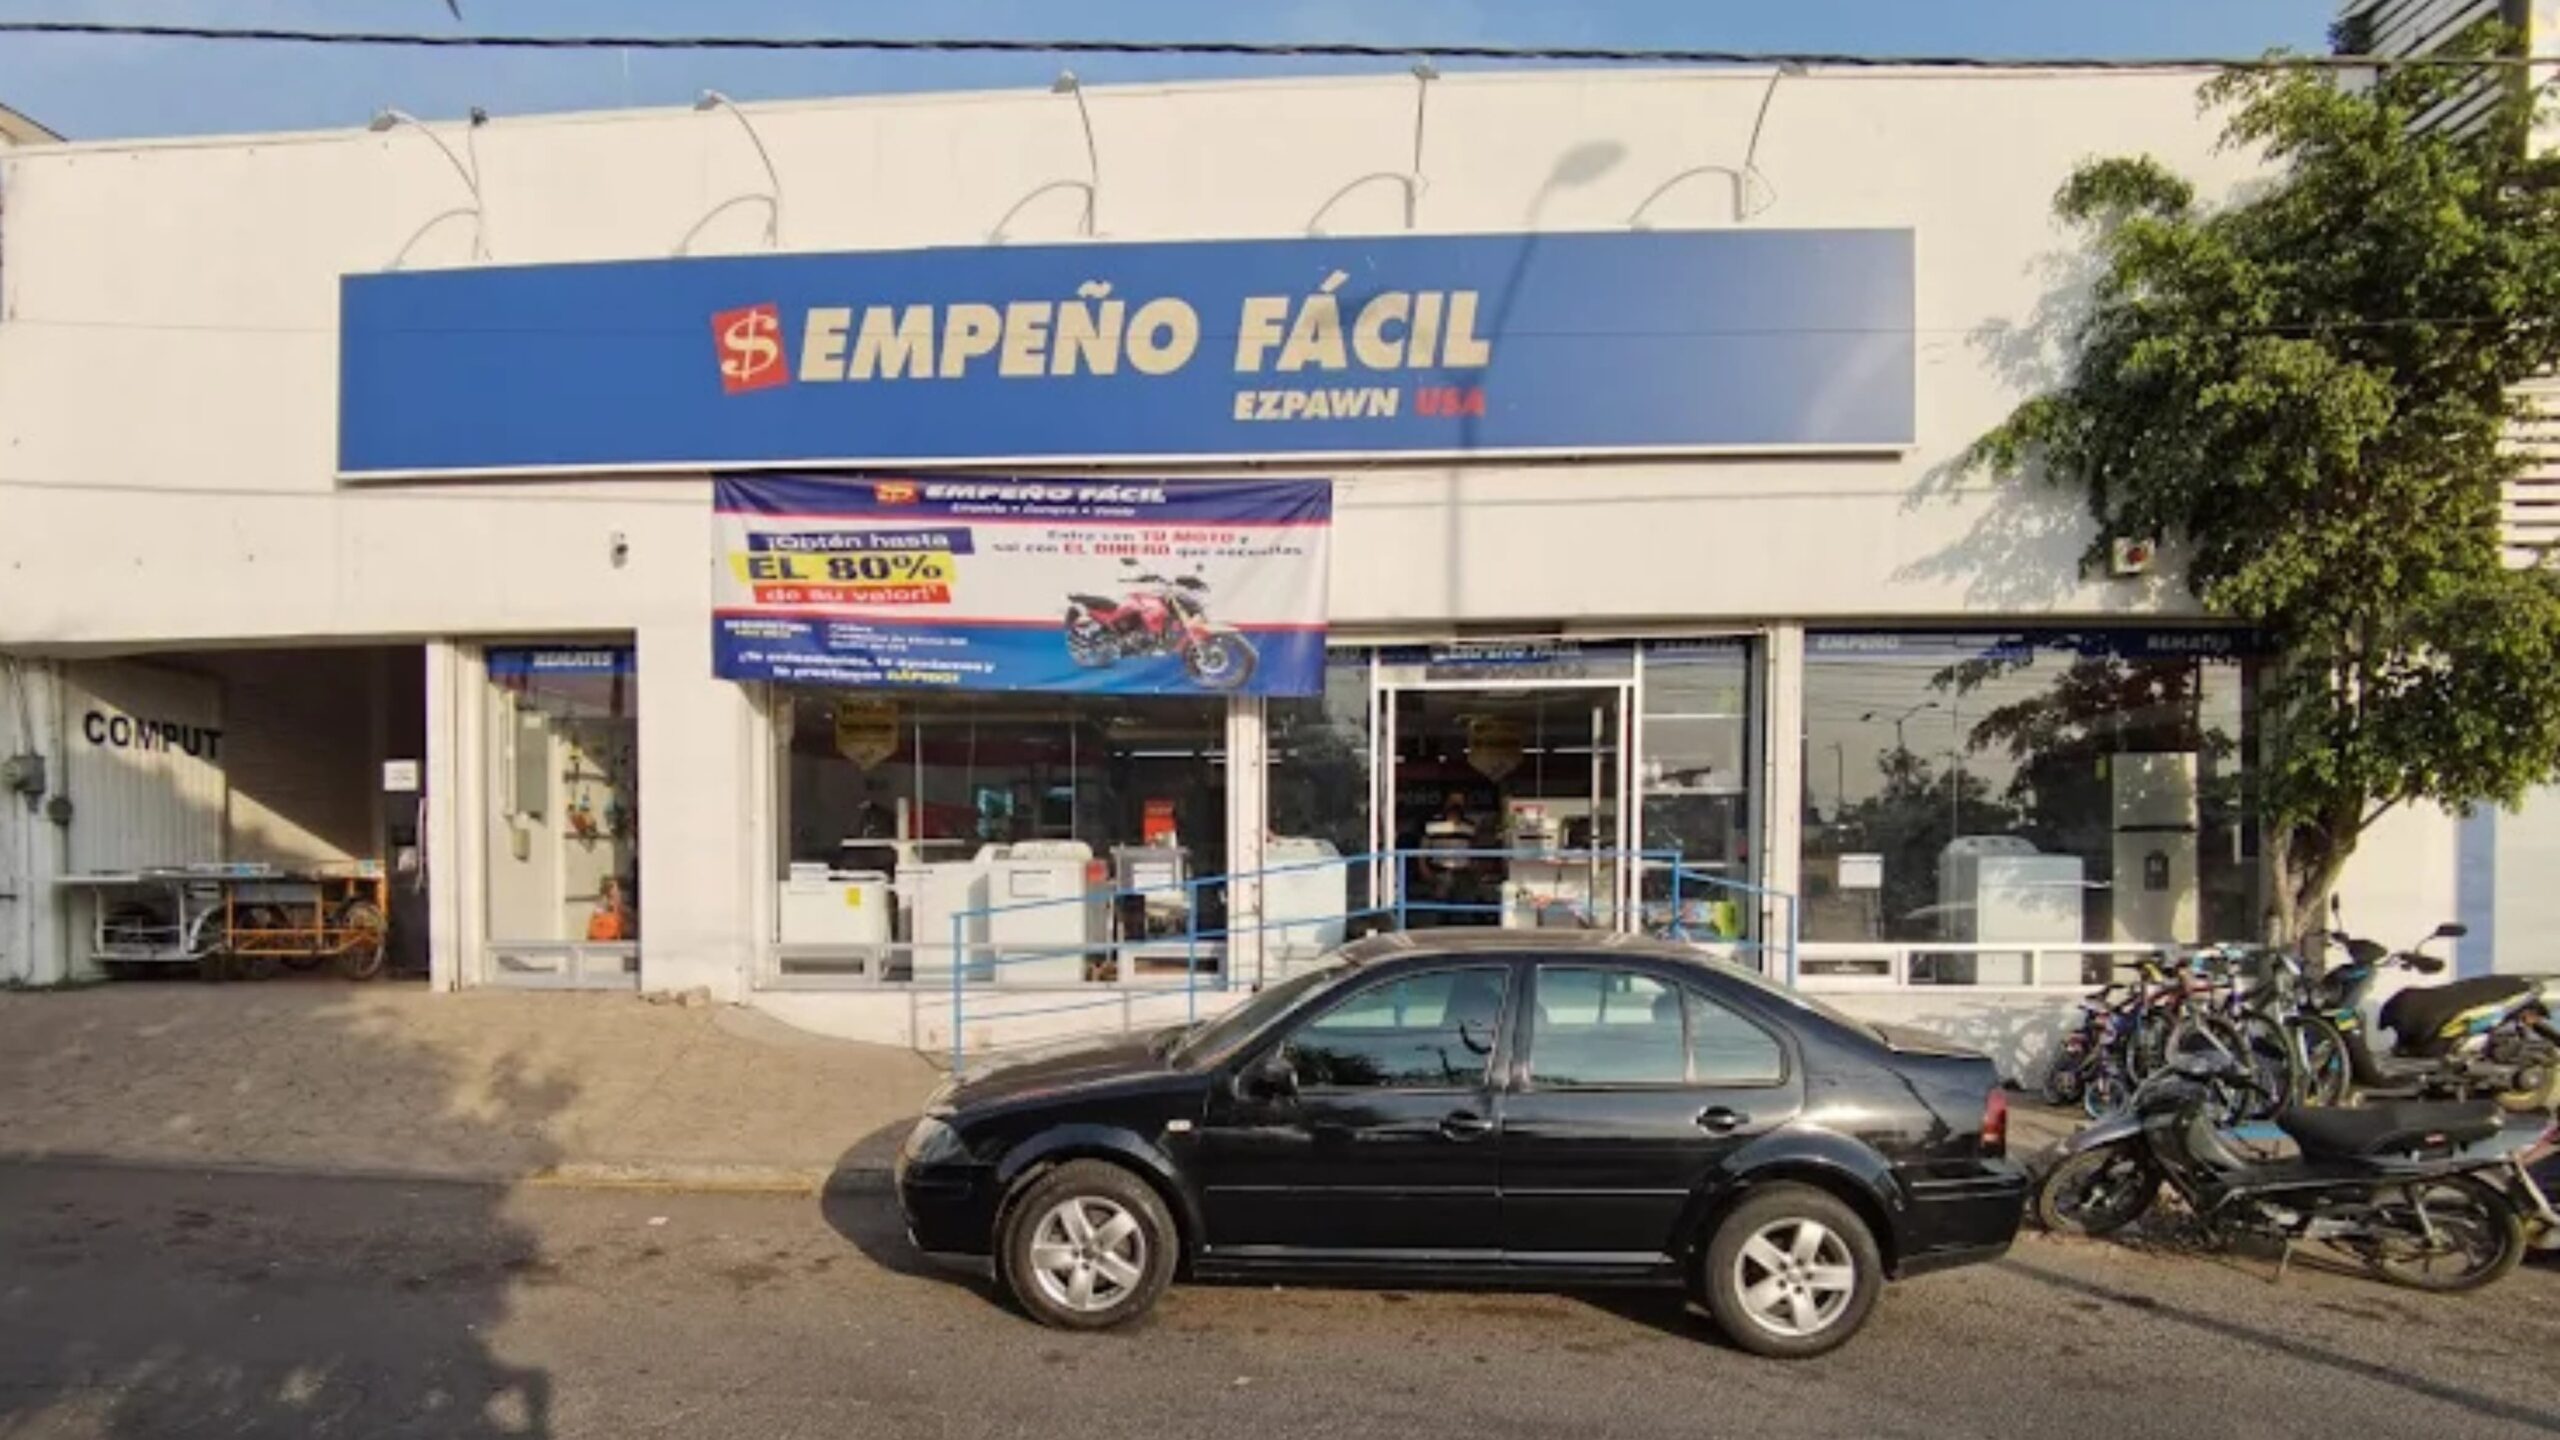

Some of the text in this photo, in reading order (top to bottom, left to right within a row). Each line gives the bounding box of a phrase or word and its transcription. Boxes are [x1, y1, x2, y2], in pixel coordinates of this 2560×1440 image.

[798, 280, 1200, 383] EMPEÑO
[1234, 269, 1492, 372] FÁCIL
[1234, 388, 1485, 420] EZPAWN USA
[925, 482, 1072, 502] EMPEÑO
[1078, 484, 1167, 504] FÁCIL
[869, 533, 951, 549] hasta
[748, 554, 943, 581] EL 80%
[765, 586, 803, 601] de
[808, 586, 845, 601] su
[84, 710, 223, 760] COMPUT
